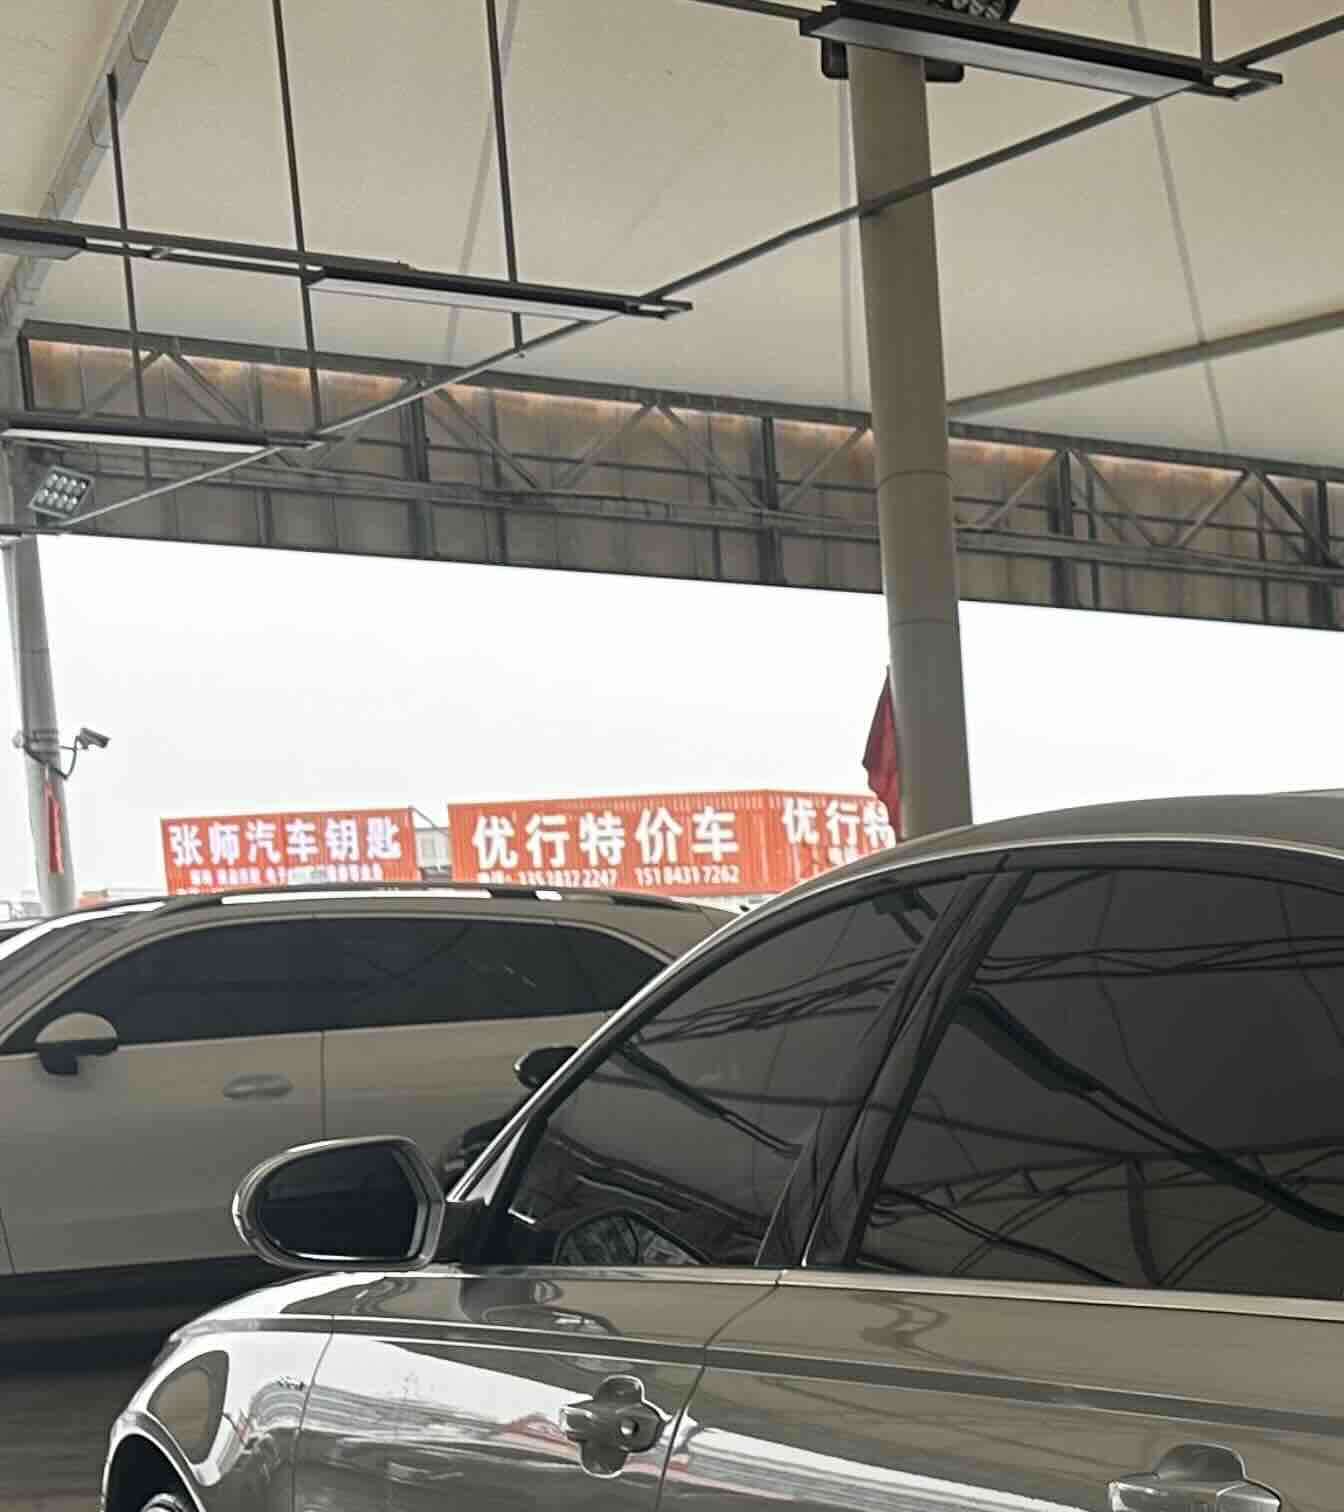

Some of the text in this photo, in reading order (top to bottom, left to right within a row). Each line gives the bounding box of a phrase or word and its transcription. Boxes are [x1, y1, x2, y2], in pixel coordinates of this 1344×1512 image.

[168, 815, 402, 867] 张师汽车钥匙
[472, 805, 740, 869] 优行特价车
